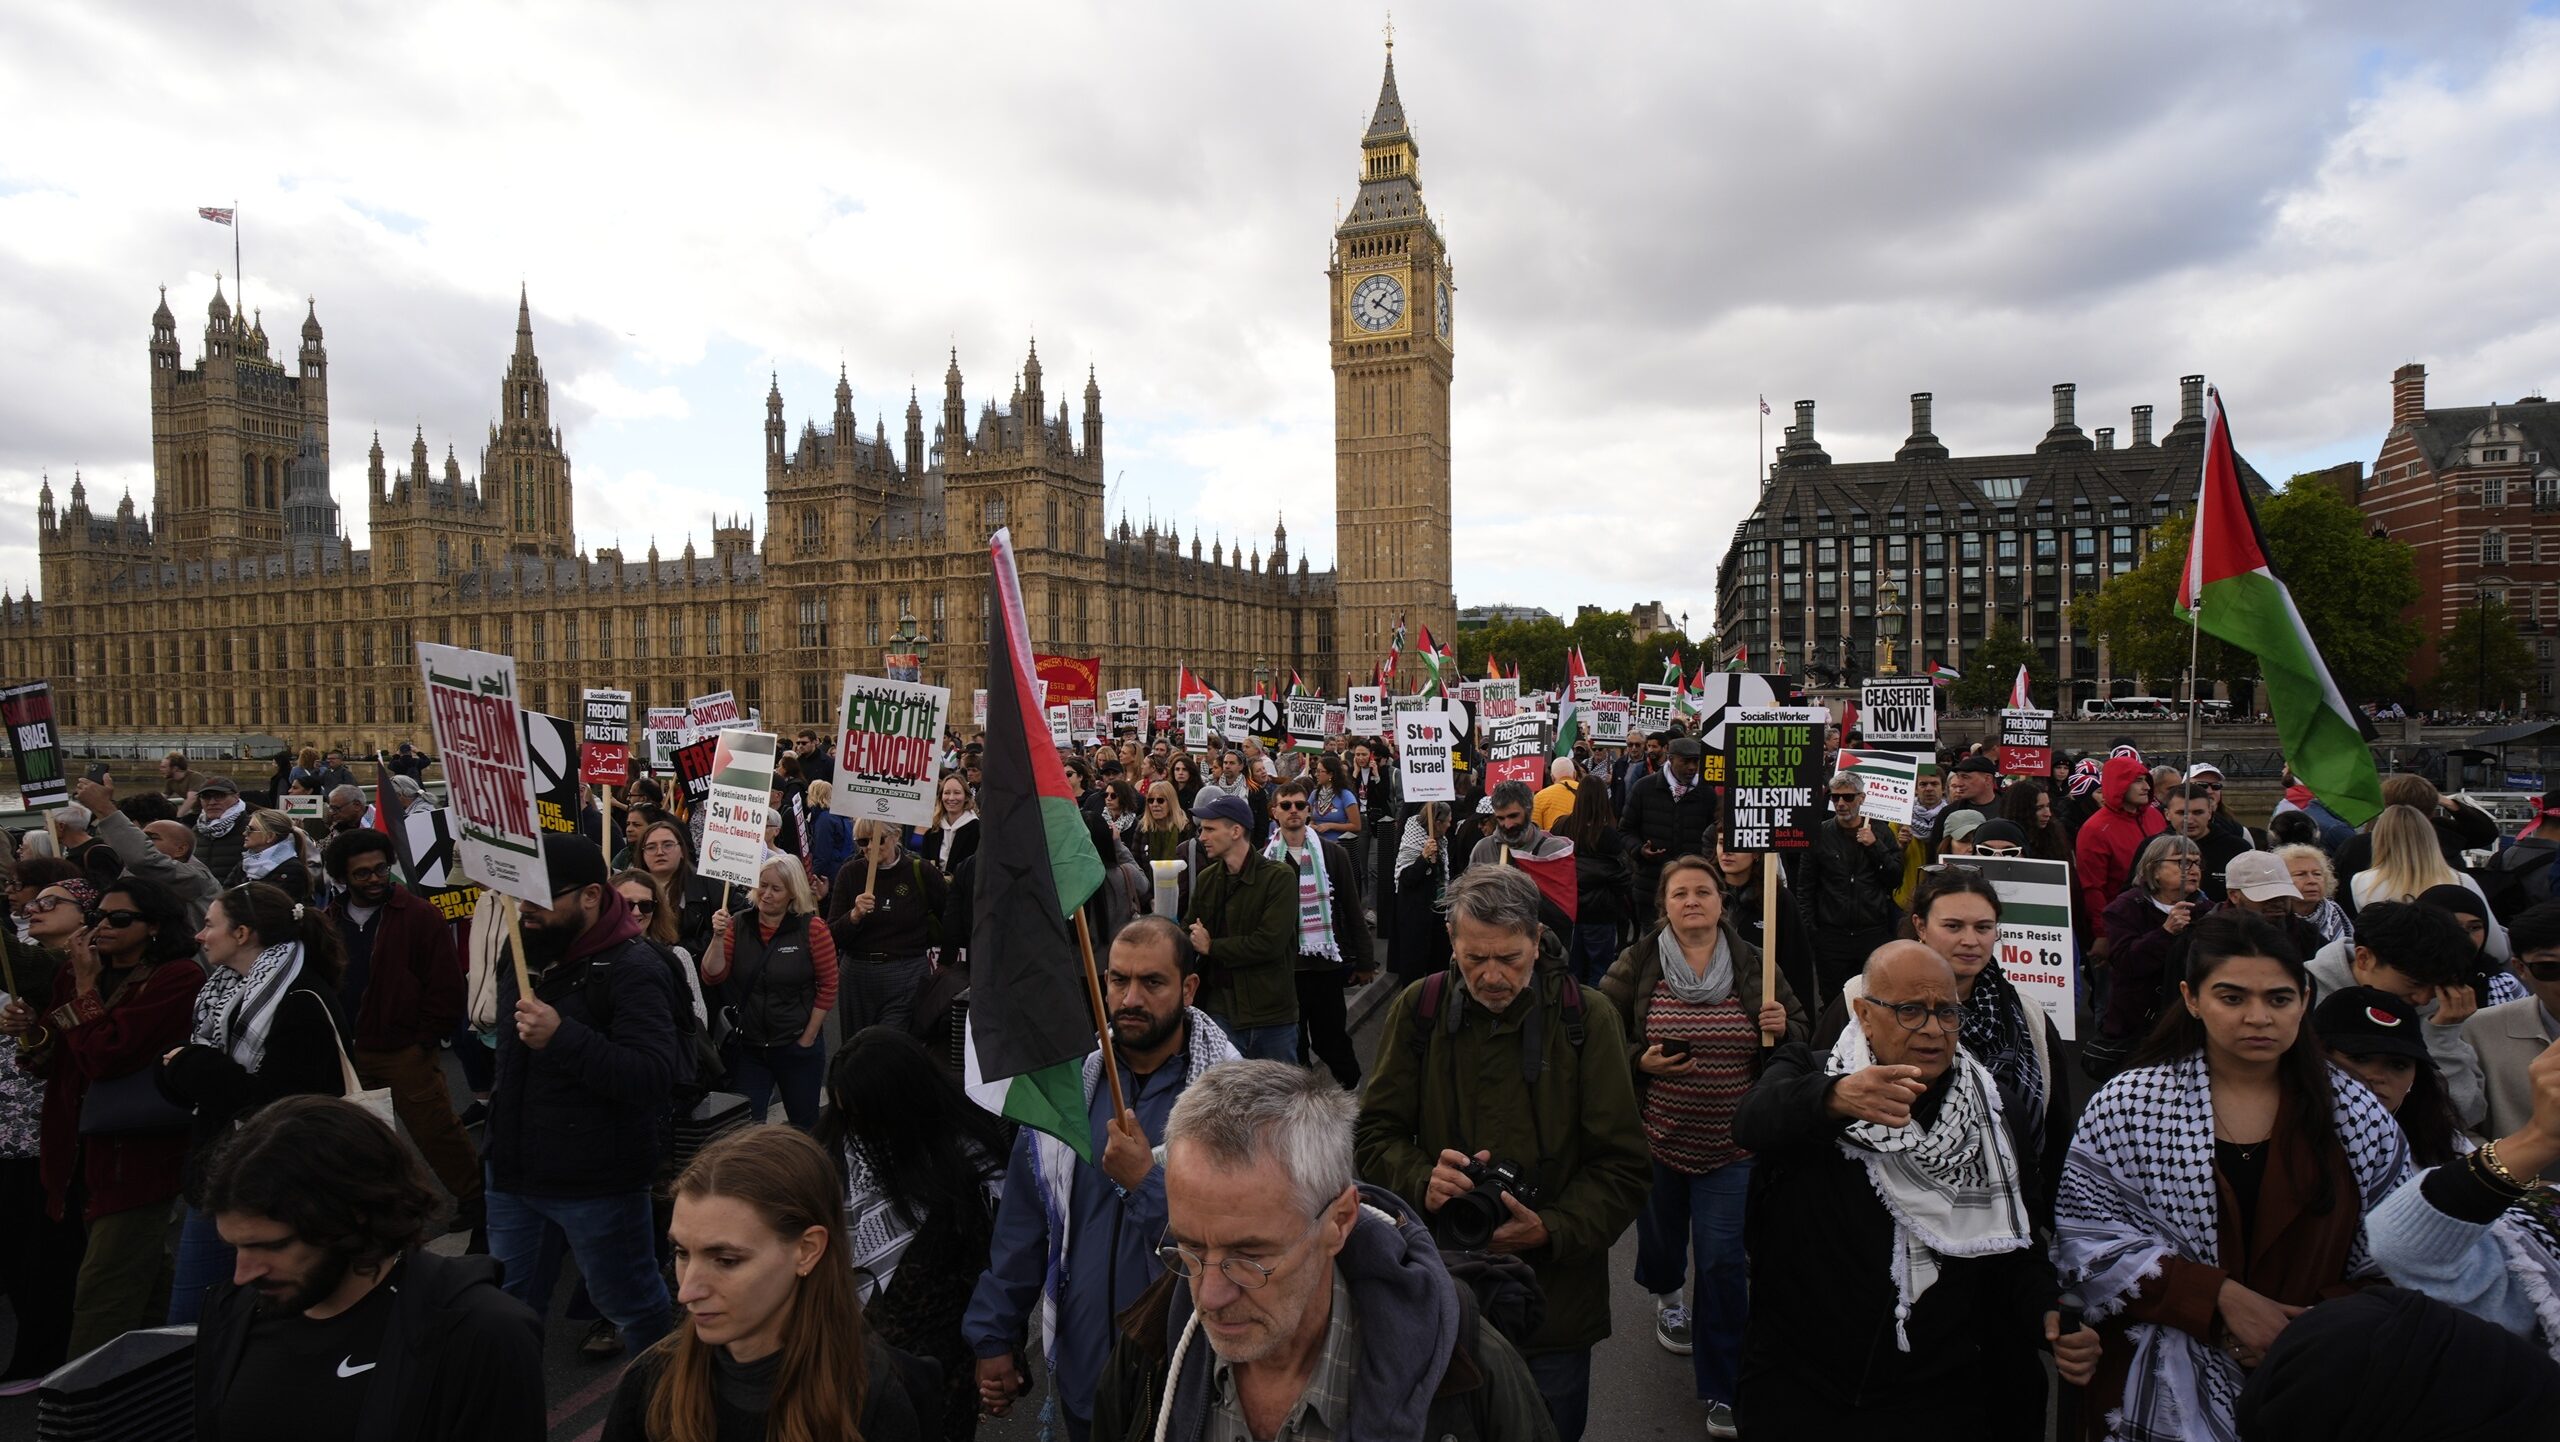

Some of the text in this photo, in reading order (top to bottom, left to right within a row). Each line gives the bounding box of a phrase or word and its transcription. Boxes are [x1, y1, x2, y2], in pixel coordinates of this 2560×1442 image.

[1354, 694, 1375, 704] Stop
[1483, 686, 1516, 700] END THE
[1865, 688, 1930, 706] CEASEFIRE
[587, 702, 627, 719] FREEDOM
[692, 700, 738, 726] SANCTION
[1072, 707, 1094, 718] FREEDOM
[1230, 706, 1249, 716] Stop
[1290, 702, 1324, 714] CEASEFIRE
[1484, 700, 1516, 717] GENOCIDE
[1592, 701, 1628, 712] SANCTION
[1638, 706, 1670, 721] FREE
[649, 715, 686, 730] SANCTION
[846, 694, 904, 735] END
[906, 703, 940, 740] THE
[1053, 712, 1066, 720] Stop
[1293, 714, 1320, 729] NOW!
[1598, 713, 1621, 722] ISRAEL
[1638, 718, 1668, 727] PALESTINE
[1741, 712, 1810, 721] Socialist Worker
[1874, 707, 1926, 732] NOW!
[431, 684, 524, 768] FREEDOM
[1072, 719, 1094, 730] PALESTINE
[1494, 723, 1539, 741] FREEDOM
[1597, 722, 1621, 735] NOW!
[2006, 719, 2046, 730] FREEDOM
[17, 722, 53, 751] ISRAEL
[584, 725, 628, 742] PALESTINE
[656, 731, 680, 744] ISRAEL
[1406, 724, 1442, 742] Stop
[1736, 726, 1810, 745] FROM THE
[2003, 734, 2048, 746] PALESTINE
[591, 746, 622, 762] الحرية
[842, 728, 936, 782] GENOCIDE
[1406, 744, 1446, 758] Arming
[1491, 742, 1541, 760] PALESTINE
[1736, 747, 1802, 766] RIVER TO
[2010, 749, 2040, 760] الحرية
[1410, 760, 1444, 773] Israel
[1736, 768, 1763, 786] THE
[1768, 768, 1794, 786] SEA
[444, 751, 536, 839] PALESTINE
[713, 788, 764, 804] Palestinians Resist
[850, 784, 920, 800] FREE PALESTINE
[1866, 790, 1908, 803] Cleansing
[1870, 782, 1907, 795] No to
[1735, 788, 1812, 807] PALESTINE
[712, 802, 762, 824] Say No to
[1734, 808, 1792, 827] WILL BE
[708, 822, 760, 843] Ethnic Cleansing
[1734, 829, 1770, 848] FREE
[705, 868, 752, 884] www.PFBUK.com
[429, 891, 461, 908] END
[2026, 930, 2062, 942] Resist
[2002, 945, 2062, 966] No to
[2007, 970, 2065, 988] leansing
